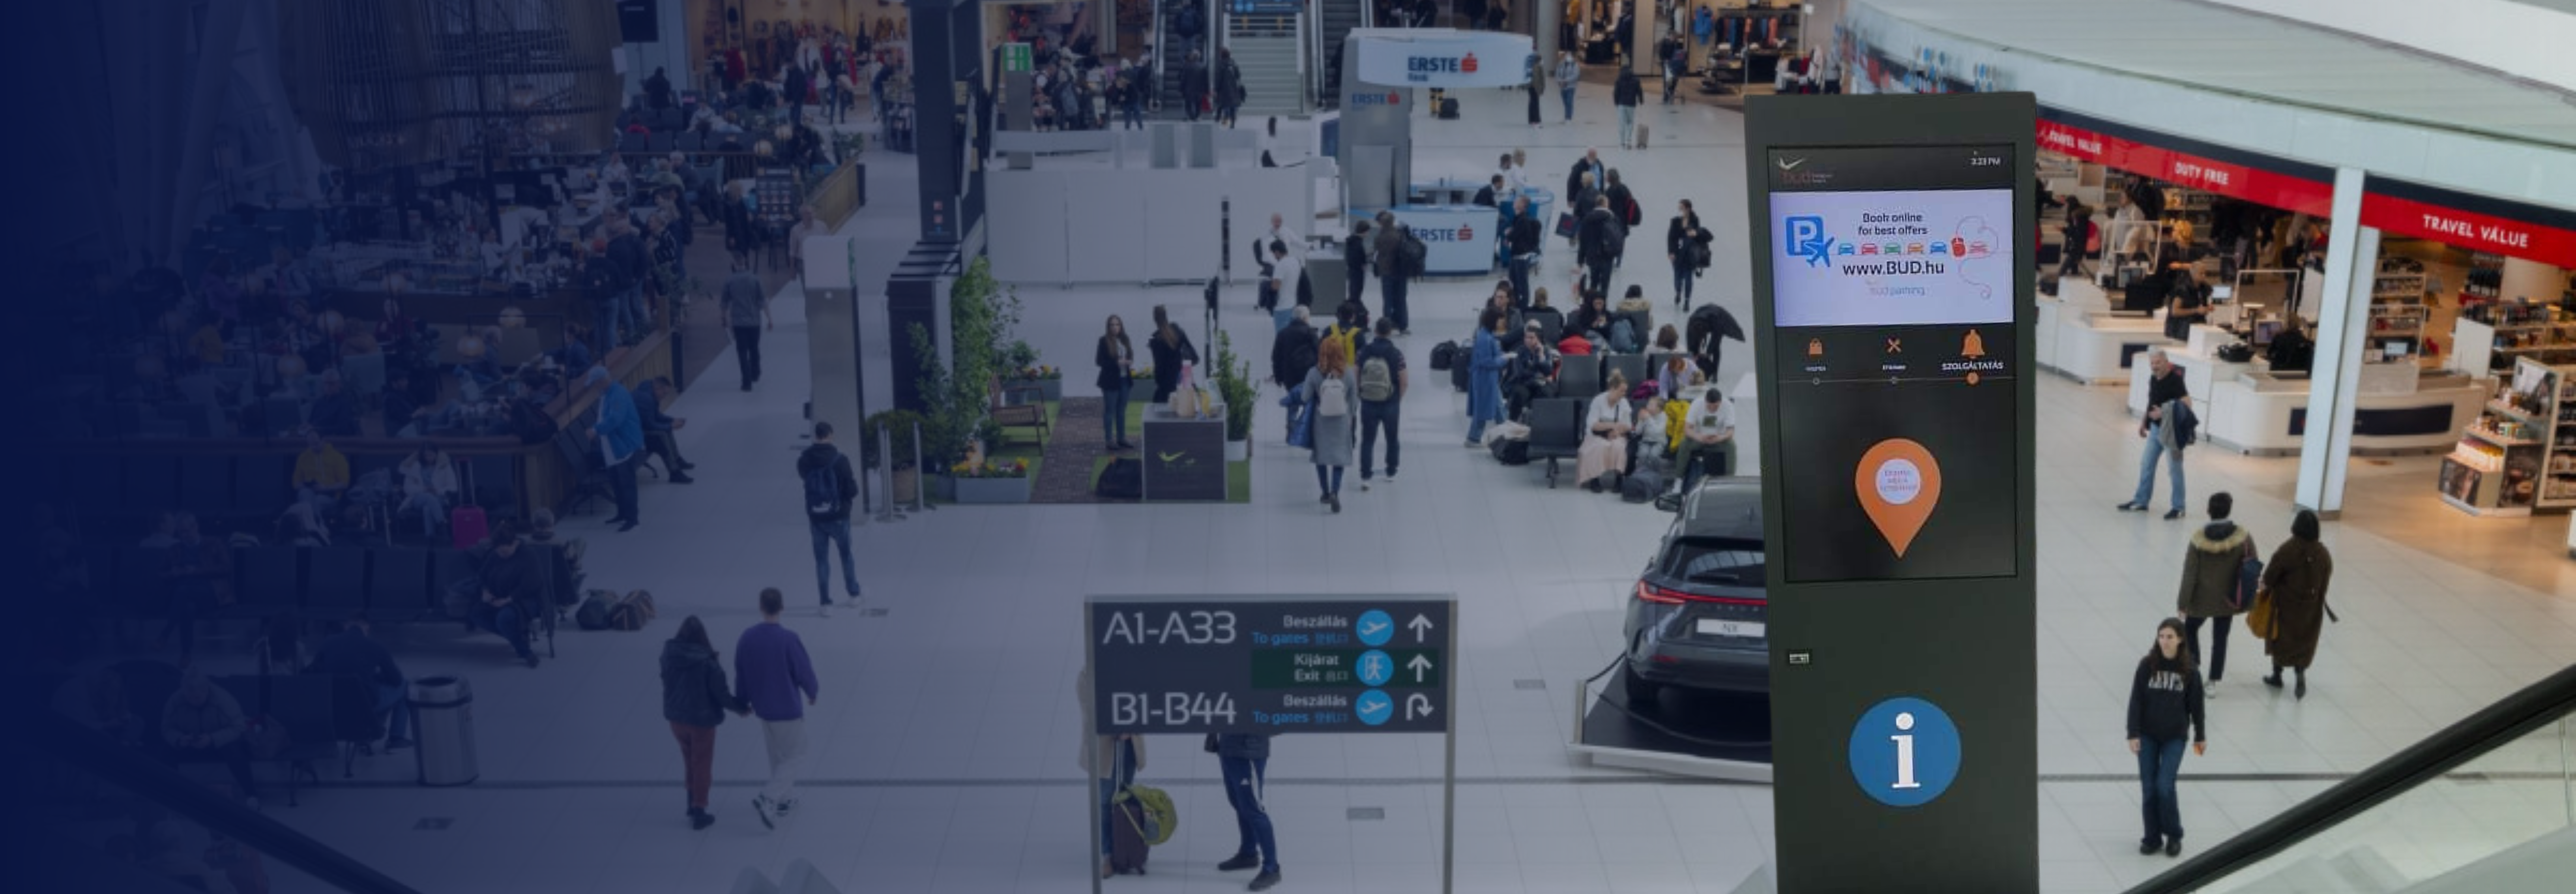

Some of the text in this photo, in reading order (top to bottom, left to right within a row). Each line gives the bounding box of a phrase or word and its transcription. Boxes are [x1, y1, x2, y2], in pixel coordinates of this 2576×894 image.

[1408, 57, 1458, 72] ERSTE
[1351, 93, 1386, 105] ERSTE
[1988, 156, 2001, 165] PM
[2175, 161, 2229, 186] DUTY FREE
[1863, 213, 1922, 222] Book online
[1857, 225, 1928, 235] for best offers
[2423, 214, 2529, 248] TRAVEL VALUE
[1842, 261, 1944, 275] www.BUD.hu
[1102, 611, 1237, 644] A1-A33
[1284, 615, 1348, 628] Beszállás
[1253, 632, 1268, 644] To
[1271, 633, 1309, 646] gates
[1294, 653, 1339, 668] Kijárat
[1295, 668, 1319, 682] Exit
[1284, 694, 1347, 707] Beszállás
[1112, 692, 1237, 725] B1-B44
[1253, 711, 1268, 723] To
[1272, 712, 1309, 725] gates
